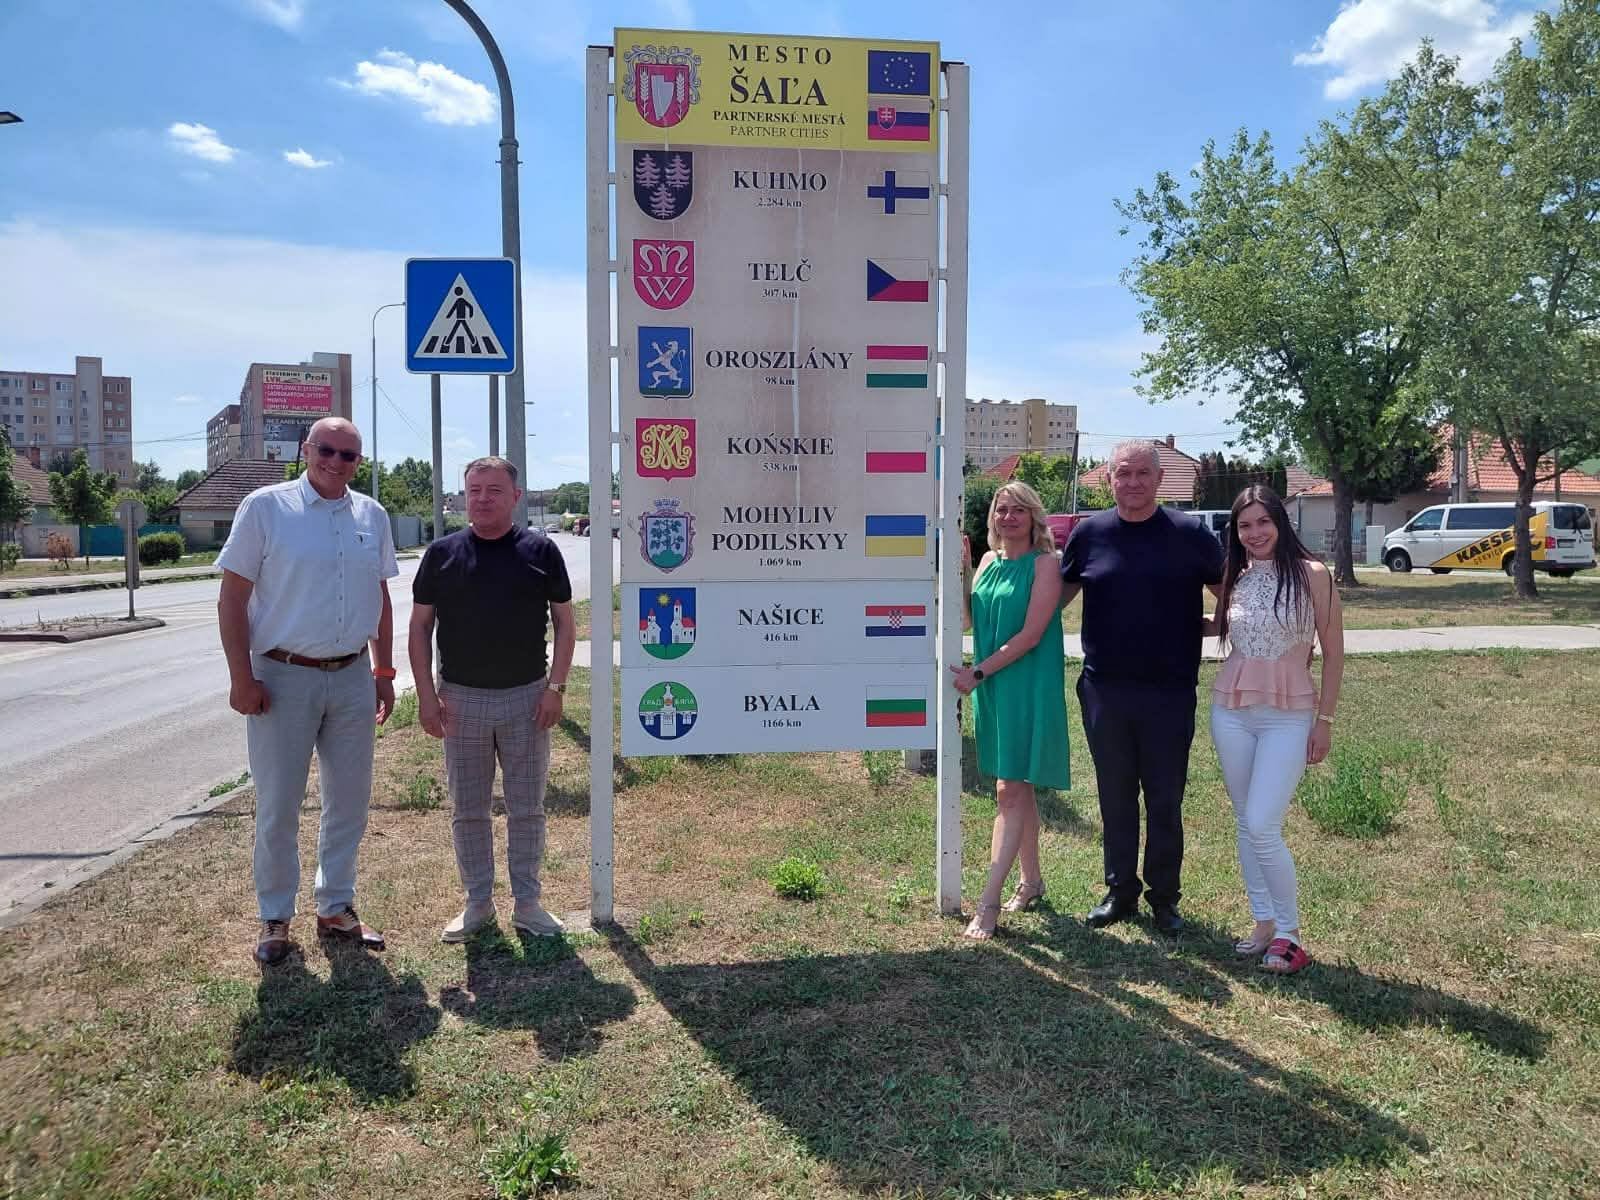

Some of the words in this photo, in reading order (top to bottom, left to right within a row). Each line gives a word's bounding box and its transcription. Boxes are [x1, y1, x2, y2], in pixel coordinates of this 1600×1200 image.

[728, 44, 832, 65] MESTO
[730, 66, 829, 106] ŠAĽA
[713, 110, 799, 123] PARTNERSKÉ
[802, 112, 846, 125] MESTÁ
[730, 125, 787, 137] PARTNER
[790, 127, 829, 138] CITIES
[733, 170, 827, 191] KUHMO
[758, 198, 783, 207] 2.284
[786, 199, 802, 208] km
[748, 258, 812, 282] TELČ
[762, 289, 779, 298] 307
[782, 289, 798, 298] km
[705, 347, 854, 370] OROSZLÁNY
[305, 373, 328, 381] Profi
[765, 377, 777, 385] 98
[779, 377, 795, 386] km
[727, 432, 834, 455] KOŃSKIE
[762, 463, 780, 472] 538
[782, 463, 798, 472] km
[722, 507, 837, 524] MOHYLIV
[712, 533, 848, 551] PODILSKYY
[759, 557, 784, 567] 1.069
[787, 557, 802, 567] km
[737, 603, 824, 626] NAŠICE
[764, 633, 781, 642] 416
[783, 633, 799, 642] km
[744, 695, 821, 712] BYALA
[762, 719, 784, 728] 1166
[786, 719, 802, 728] km
